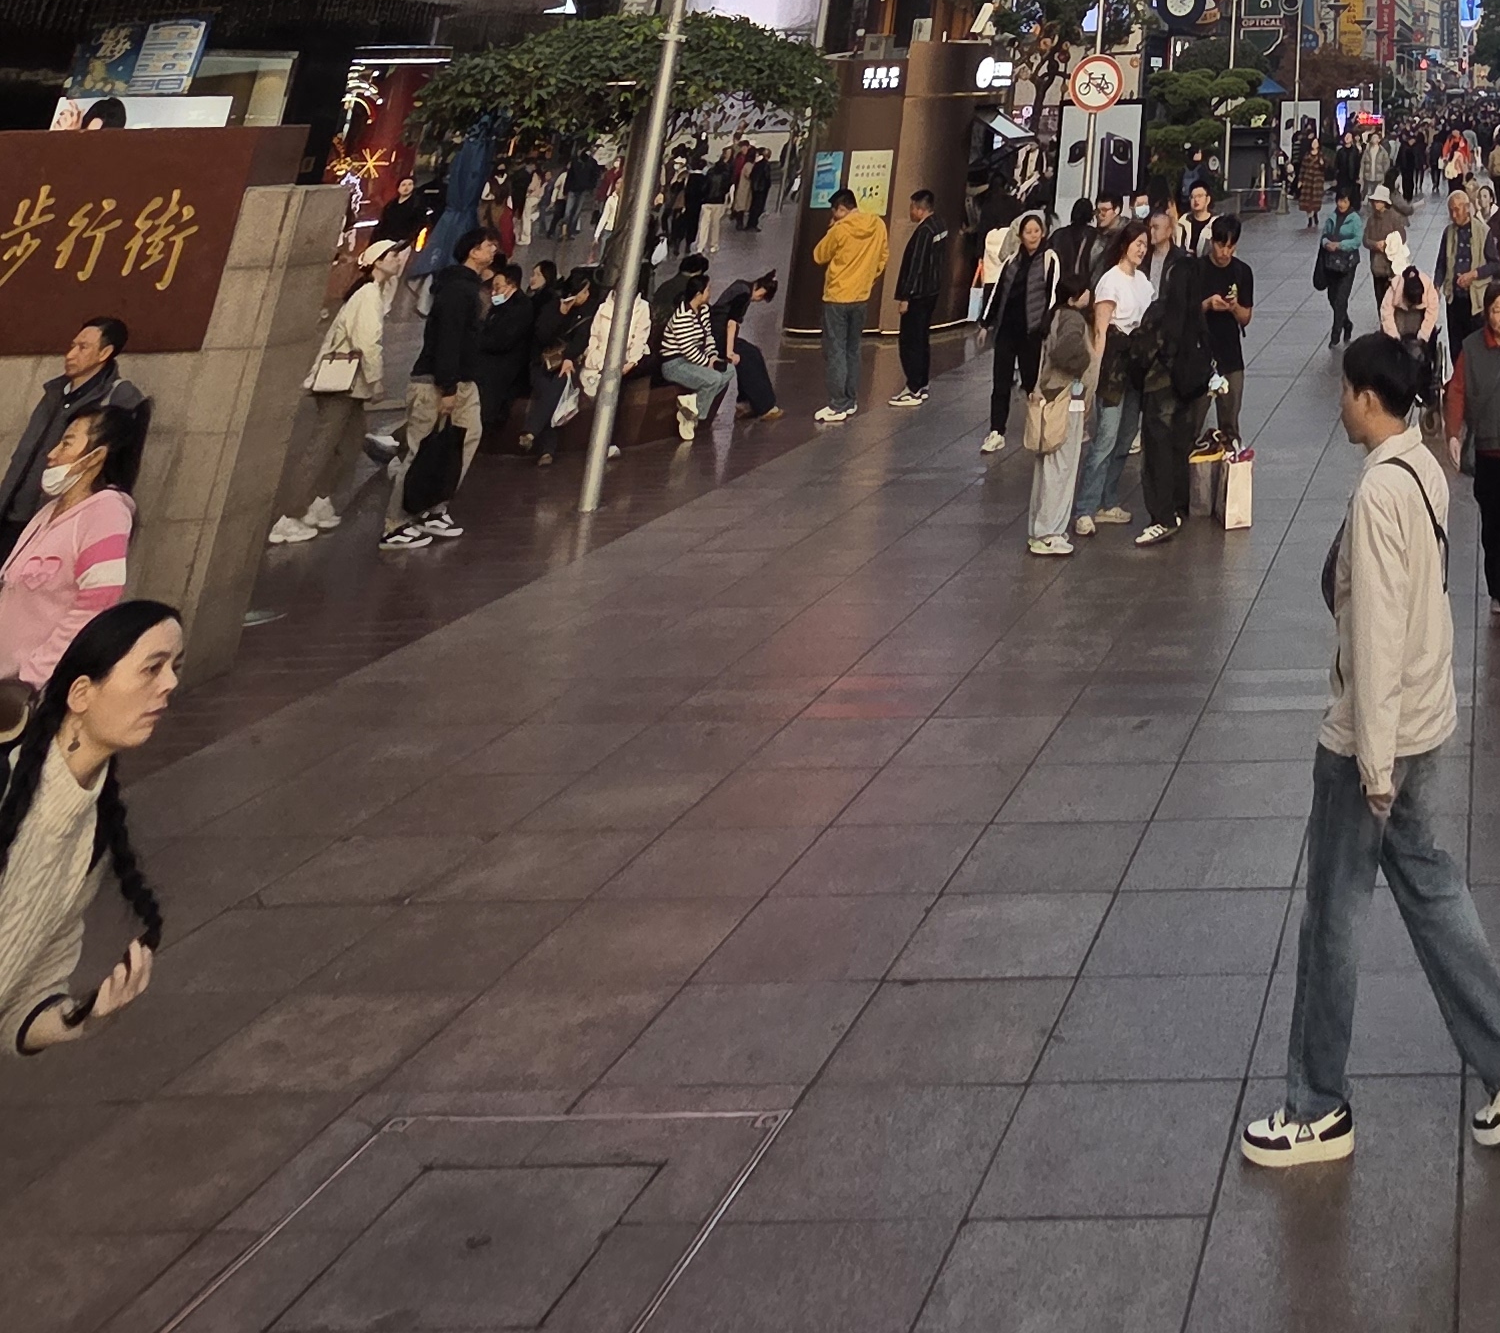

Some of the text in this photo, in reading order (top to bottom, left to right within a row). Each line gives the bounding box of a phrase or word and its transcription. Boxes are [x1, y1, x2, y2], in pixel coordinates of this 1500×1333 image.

[1241, 19, 1282, 28] OPTICAL
[0, 184, 199, 291] 步行街
